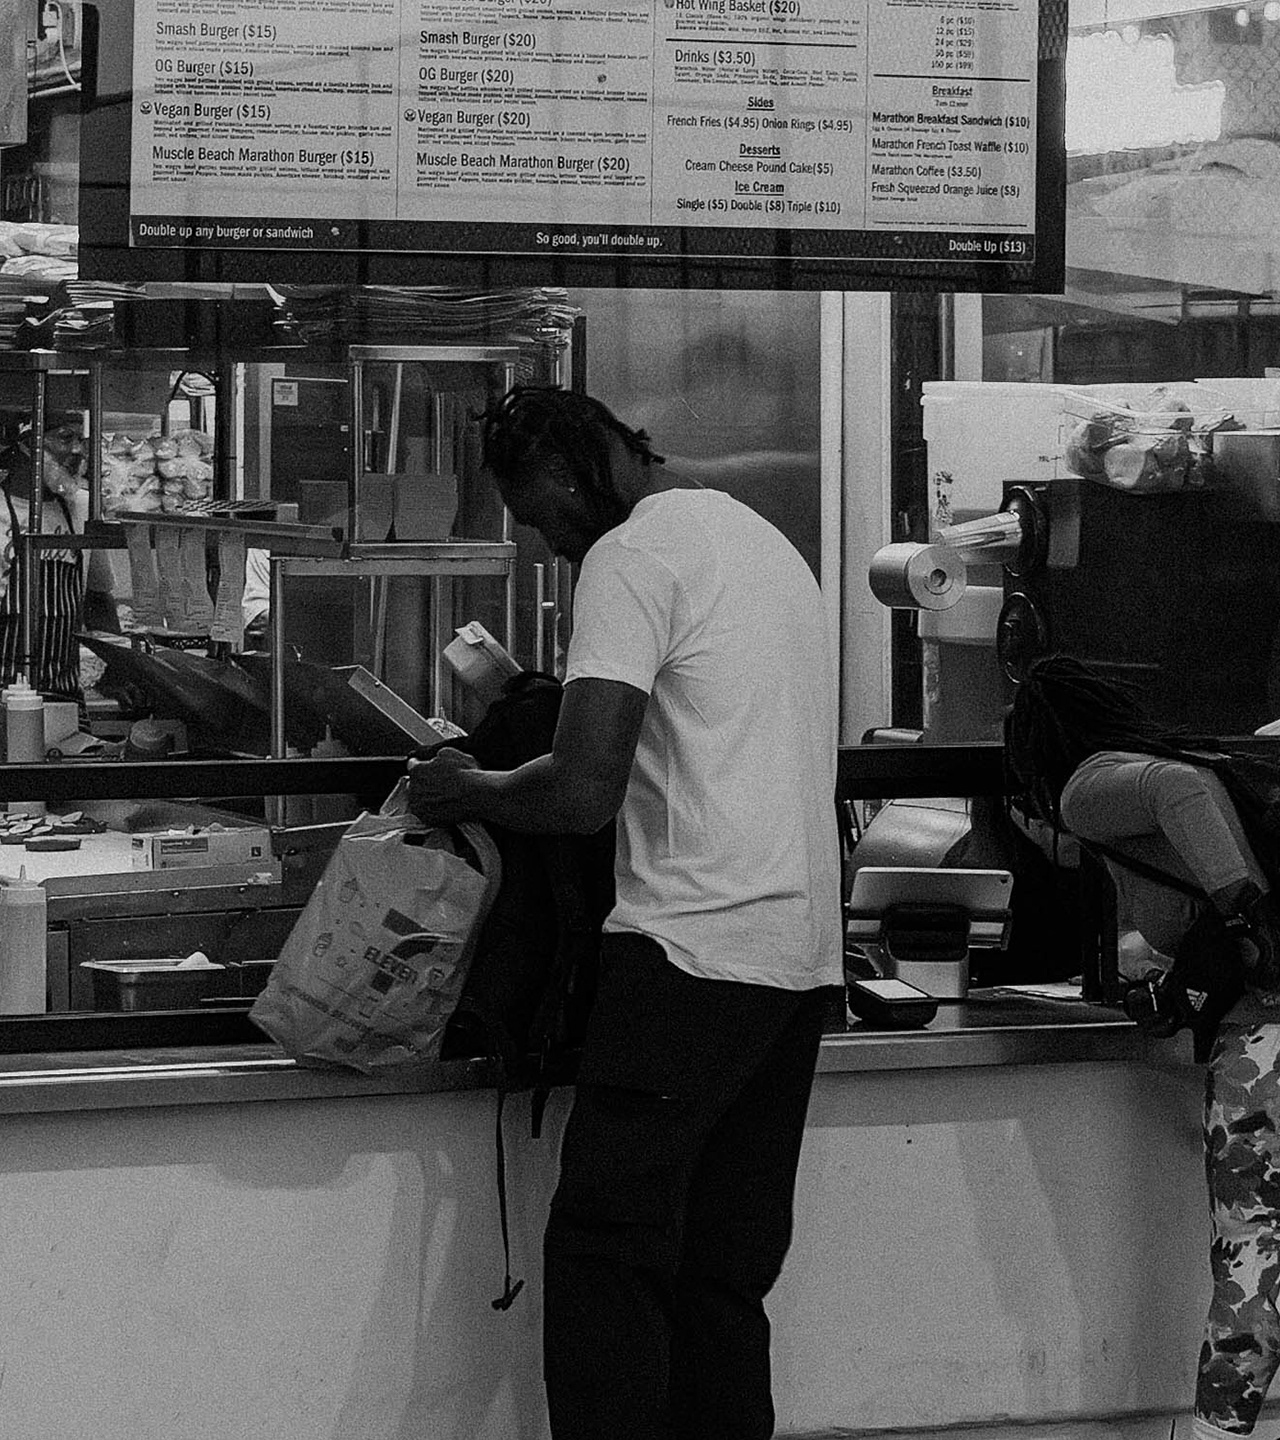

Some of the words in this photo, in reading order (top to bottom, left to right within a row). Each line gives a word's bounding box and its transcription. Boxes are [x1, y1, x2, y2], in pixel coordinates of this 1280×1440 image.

[729, 0, 766, 13] Basket
[769, 0, 801, 15] ($20)
[156, 22, 196, 36] Smash
[200, 23, 239, 39] Burger
[242, 24, 277, 40] ($15)
[420, 30, 458, 45] Smash
[463, 32, 500, 48] Burger
[503, 33, 536, 48] ($20)
[675, 49, 709, 63] Drinks
[713, 51, 756, 66] ($3.50)
[155, 59, 173, 72] OG
[177, 60, 215, 77] Burger
[219, 61, 254, 77] ($15)
[419, 68, 436, 80] OG
[440, 69, 478, 84] Burger
[481, 70, 514, 84] ($20)
[932, 86, 973, 96] Breakfast
[748, 96, 774, 108] Sides
[153, 102, 190, 119] Vegan
[194, 103, 233, 120] Burger
[236, 104, 271, 120] ($15)
[417, 109, 453, 126] Vegan
[457, 110, 494, 127] Burger
[498, 111, 531, 127] ($20)
[667, 115, 697, 127] French
[700, 116, 721, 128] Fries
[724, 117, 759, 130] ($4.95)
[762, 118, 788, 129] Onion
[791, 119, 816, 132] Rings
[818, 120, 853, 133] ($4.95)
[872, 112, 914, 124] Marathon
[917, 113, 958, 125] Breakfast
[961, 115, 1002, 126] Sandwich
[1005, 116, 1030, 128] ($10)
[739, 143, 781, 156] Desserts
[872, 138, 914, 150] Marathon
[916, 139, 946, 151] French
[948, 140, 972, 152] Toast
[974, 141, 1002, 153] Waffle
[1004, 142, 1029, 155] ($10)
[152, 146, 194, 160] Muscle
[198, 147, 235, 161] Beach
[239, 148, 295, 163] Marathon
[299, 149, 337, 166] Burger
[340, 150, 375, 166] ($15)
[416, 152, 457, 166] Muscle
[461, 153, 496, 167] Beach
[500, 154, 553, 169] Marathon
[557, 156, 594, 172] Burger
[597, 157, 630, 172] ($20)
[685, 159, 716, 172] Cream
[719, 160, 753, 173] Cheese
[756, 161, 787, 174] Pound
[872, 164, 914, 175] Marathon
[916, 166, 945, 177] Coffee
[947, 166, 982, 179] ($3.50)
[735, 180, 750, 192] Ice
[753, 181, 784, 193] Cream
[871, 182, 895, 193] Fresh
[898, 183, 940, 195] Squeezed
[943, 184, 974, 197] Orange
[976, 185, 998, 196] Juice
[1001, 185, 1020, 198] ($8)
[677, 198, 705, 212] Single
[708, 199, 728, 212] ($5)
[731, 200, 762, 212] Double
[788, 201, 812, 214] Triple
[815, 201, 841, 214] ($10)
[139, 223, 176, 237] Double
[179, 226, 193, 238] up
[195, 227, 214, 239] any
[216, 224, 250, 240] burger
[252, 227, 263, 238] or
[266, 226, 314, 239] sandwich
[536, 231, 549, 244] So
[552, 232, 580, 247] good,
[582, 232, 608, 247] you'll
[611, 233, 644, 246] double
[647, 235, 663, 248] up.
[949, 240, 981, 252] Double
[984, 241, 997, 253] Up
[999, 241, 1026, 253] ($13)
